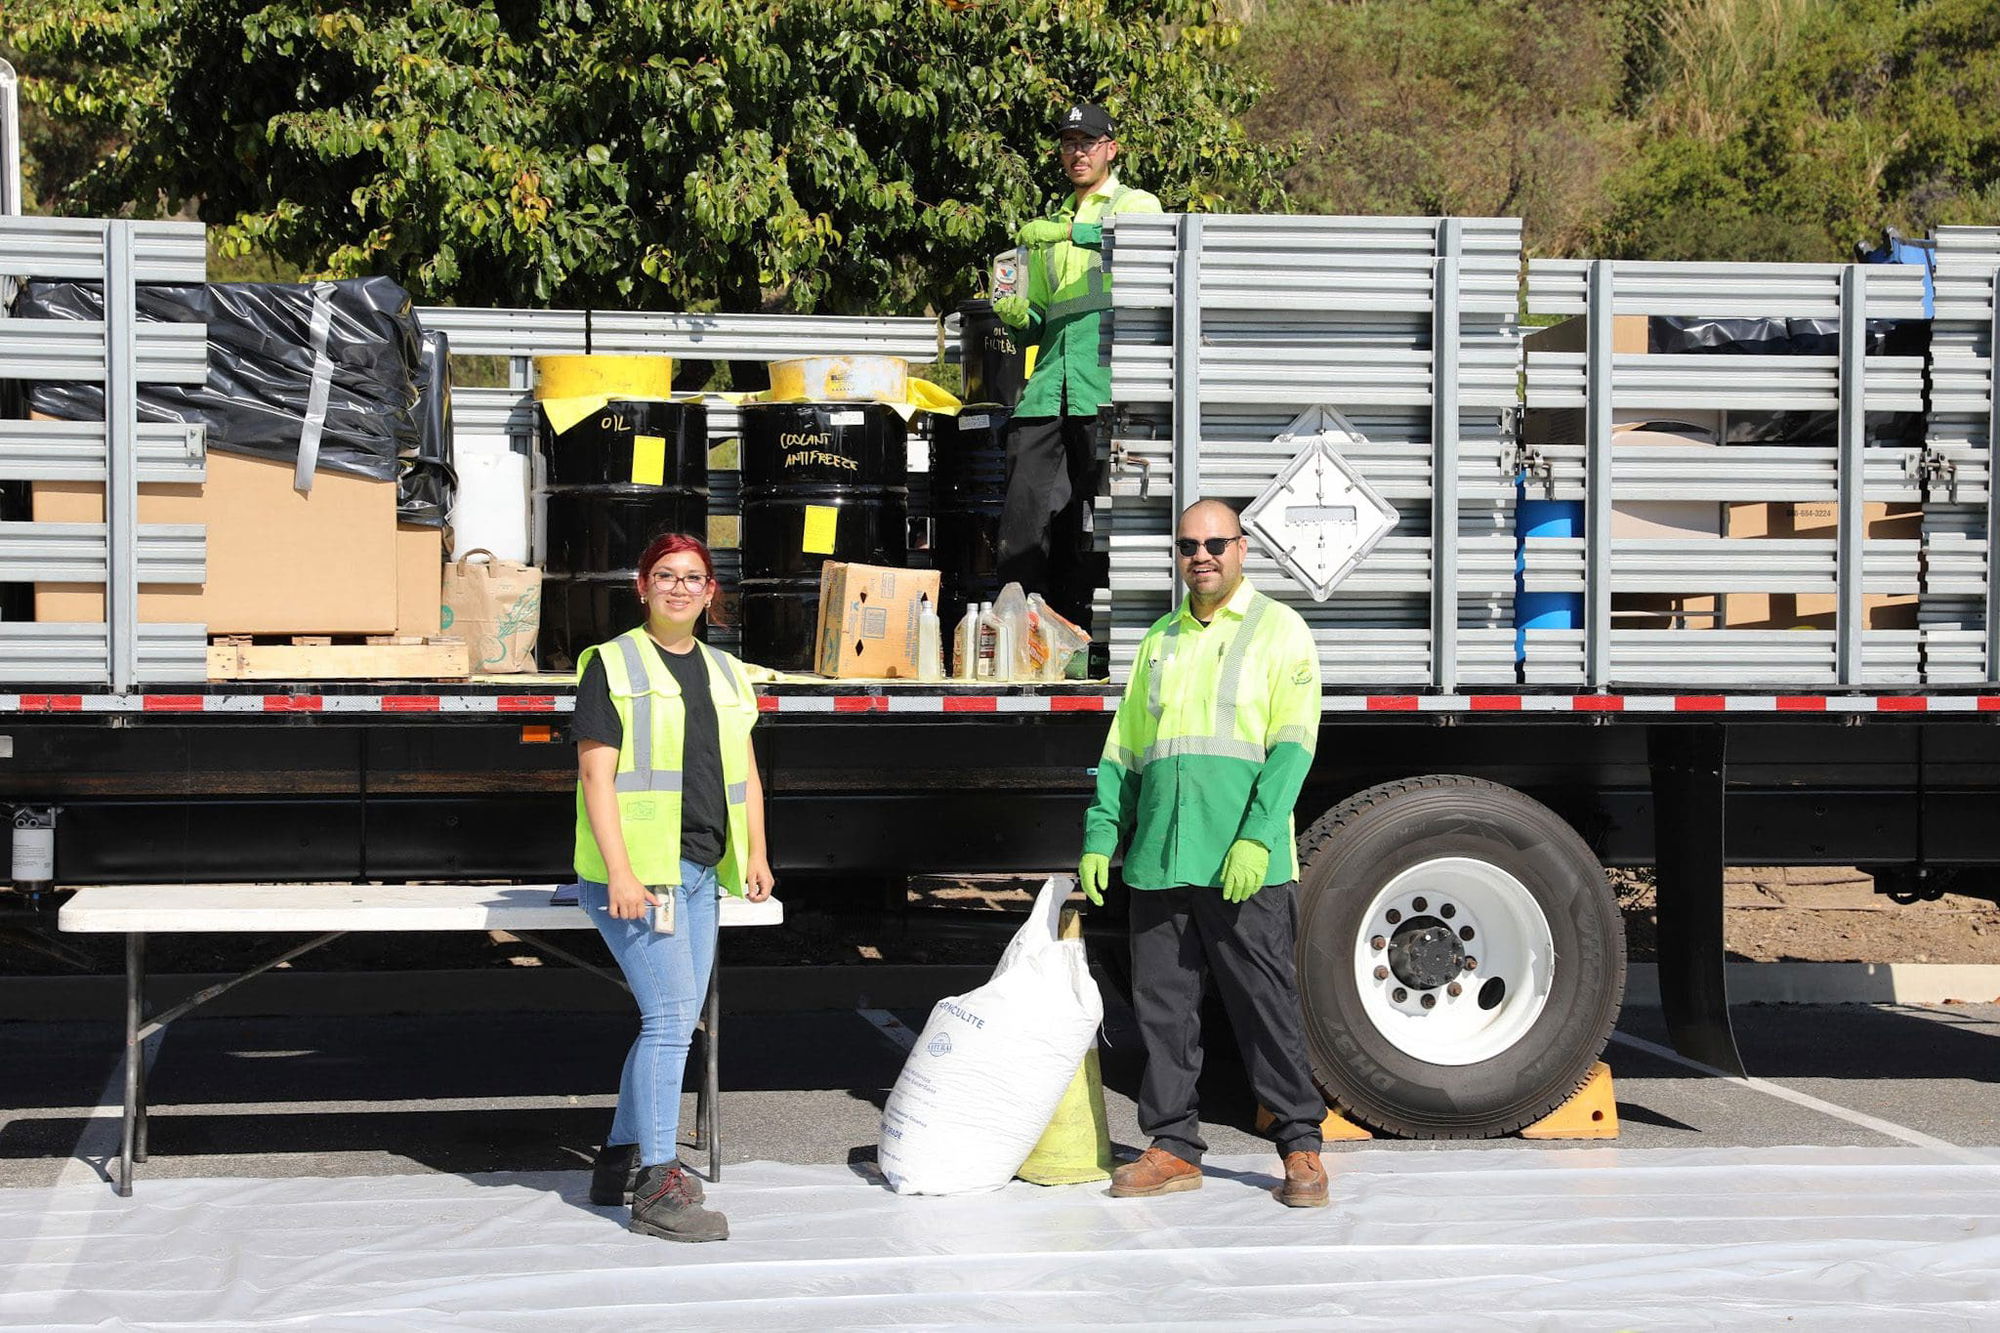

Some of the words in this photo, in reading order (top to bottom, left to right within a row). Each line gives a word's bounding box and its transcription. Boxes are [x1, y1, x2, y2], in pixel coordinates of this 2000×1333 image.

[993, 327, 1008, 336] OIL
[984, 336, 1017, 355] FILTERS
[601, 414, 631, 432] OIL
[780, 432, 832, 449] COOLANT
[784, 450, 859, 471] ANTIFREEZE
